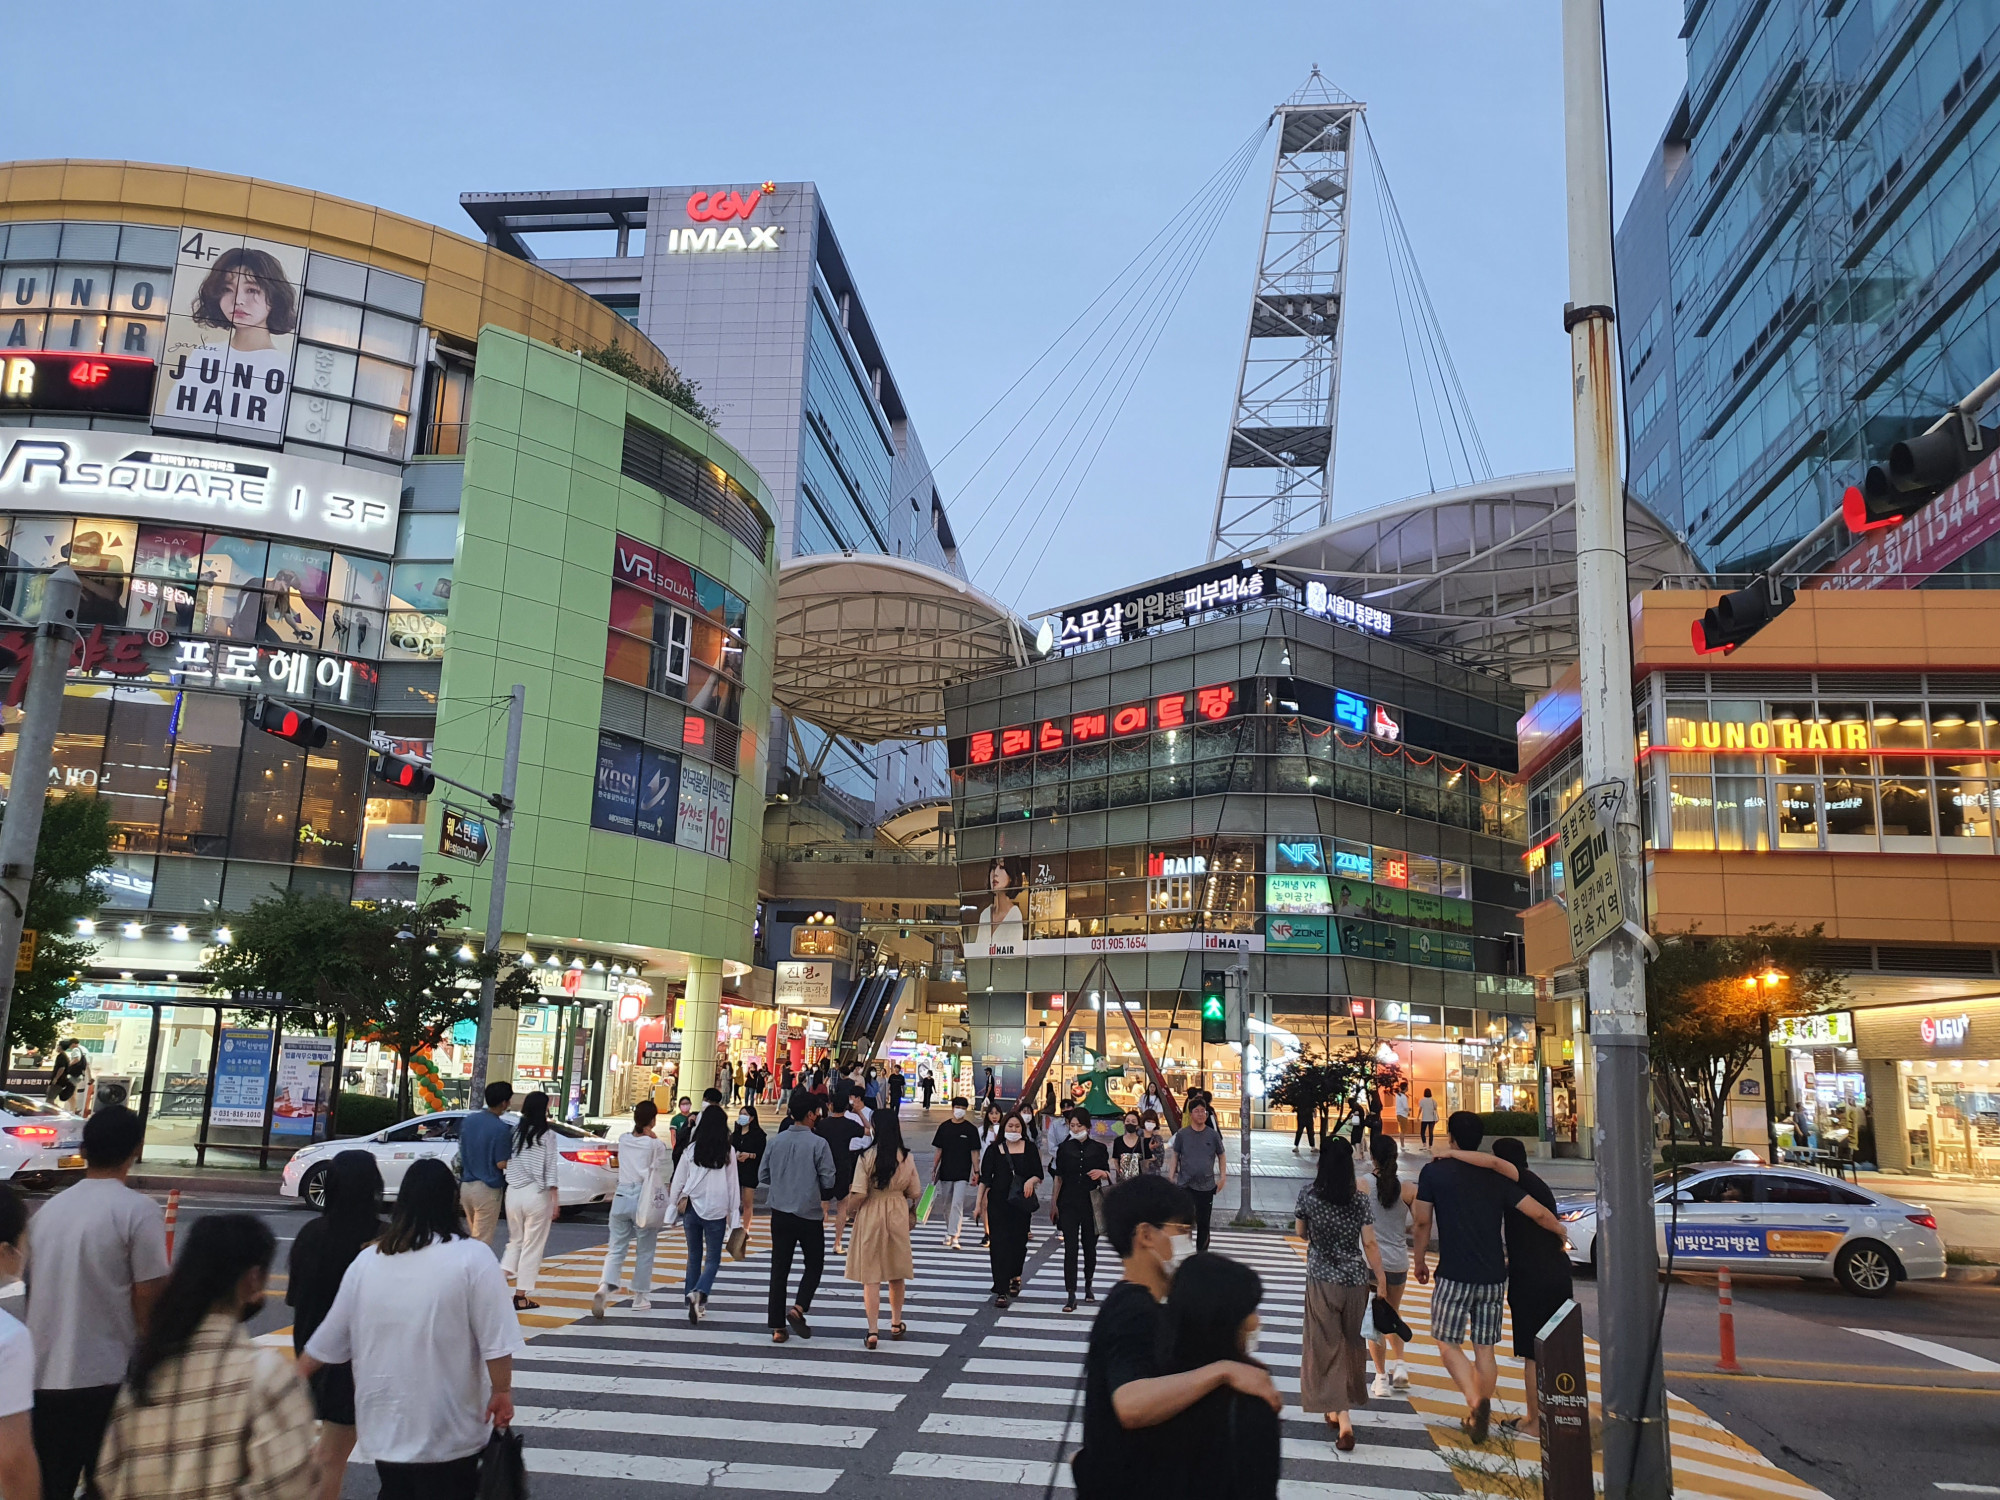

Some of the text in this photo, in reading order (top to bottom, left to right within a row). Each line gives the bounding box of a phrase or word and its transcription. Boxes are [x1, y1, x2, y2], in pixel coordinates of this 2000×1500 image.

[687, 190, 761, 222] CGV
[181, 233, 221, 261] 4F
[669, 226, 780, 252] IMAX
[168, 334, 218, 352] garden
[72, 363, 110, 383] 4F
[169, 355, 285, 394] JUNO
[176, 385, 267, 422] HAIR
[77, 463, 267, 506] SQUARE
[330, 496, 386, 524] 3F
[154, 536, 188, 546] PLAY
[282, 552, 321, 565] ENJOY
[620, 547, 655, 583] VR
[1327, 594, 1392, 633] 서울대 동문병원
[169, 640, 352, 701] 프로헤어
[1335, 692, 1368, 731] 락
[1682, 720, 1868, 750] JUNO HAIR
[446, 817, 480, 845] 웨스턴돔
[710, 806, 730, 856] 1위
[444, 838, 478, 860] WesternDom
[1278, 843, 1406, 880] VR ZONE BE
[1272, 879, 1317, 889] 신개념 VR
[1275, 891, 1313, 901] 놀이공간
[1271, 924, 1294, 938] VR
[1294, 929, 1325, 938] ZONE
[1573, 893, 1620, 949] 단속지역
[1091, 936, 1147, 950] 031.905.1654
[996, 1031, 1012, 1046] Day
[218, 1109, 261, 1118] 031-816-1010
